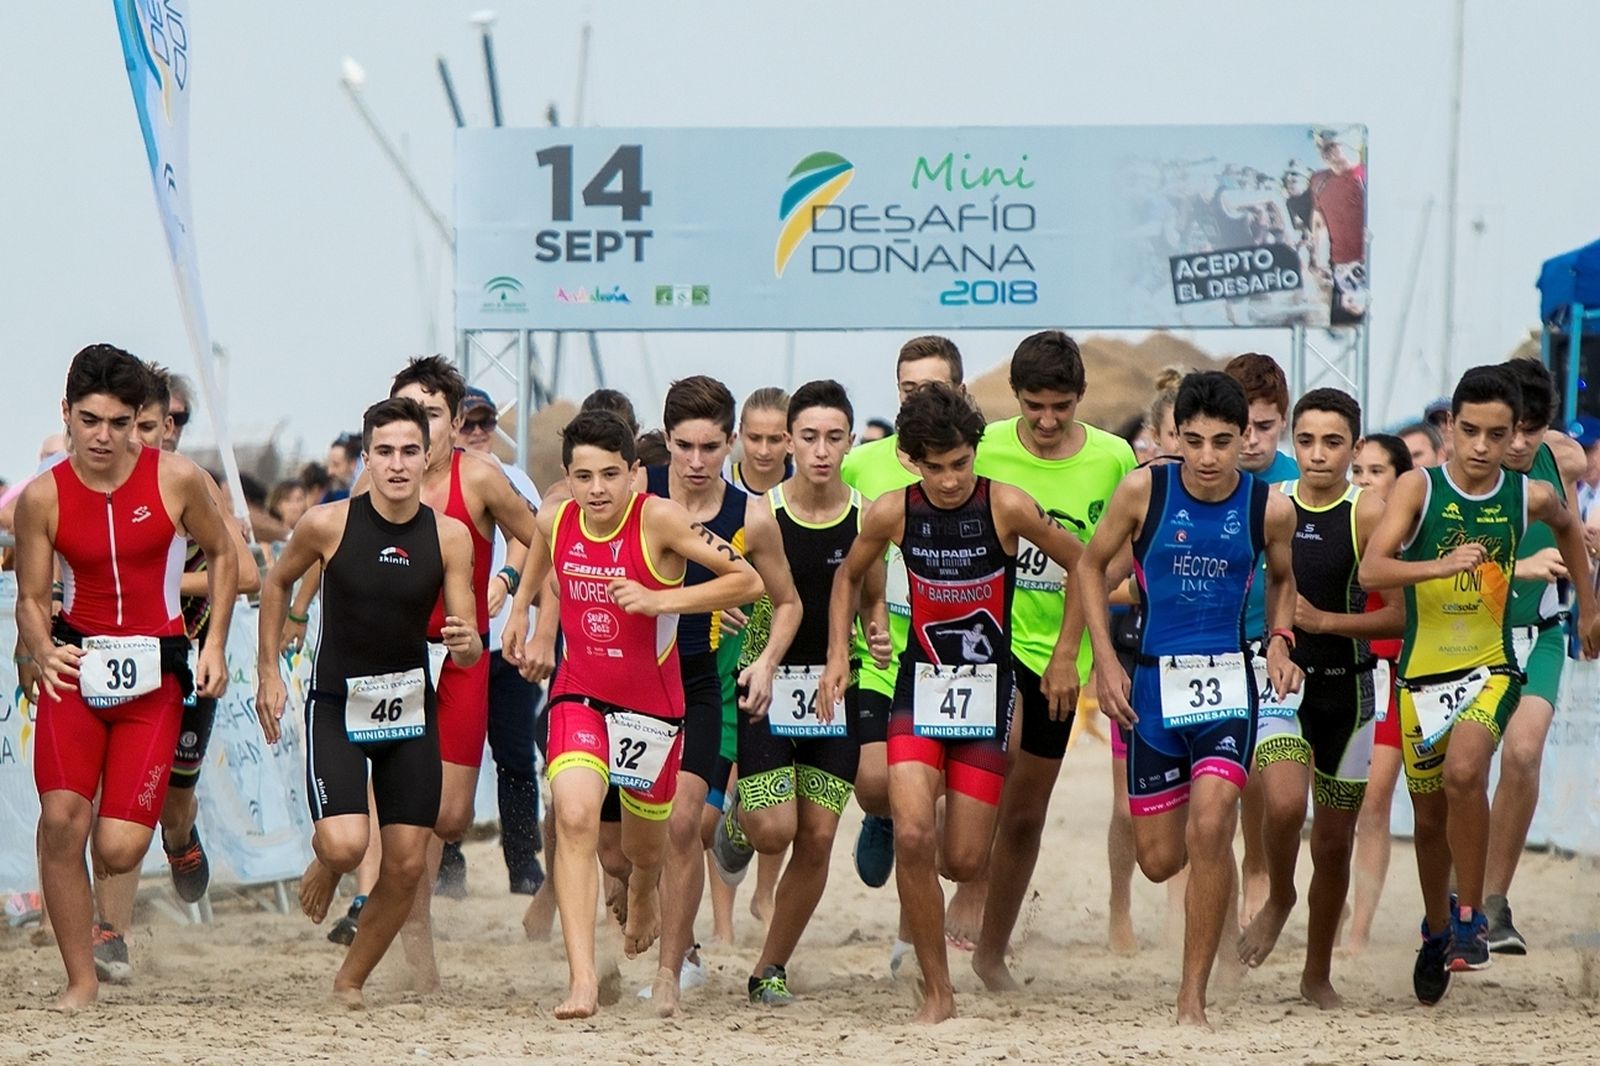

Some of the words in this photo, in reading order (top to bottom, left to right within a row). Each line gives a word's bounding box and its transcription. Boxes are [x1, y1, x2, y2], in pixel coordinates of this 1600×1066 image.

[536, 144, 653, 221] 14
[911, 153, 1035, 191] Mini
[812, 193, 1036, 233] DESAFÍO
[535, 230, 653, 262] SEPT
[812, 238, 1036, 274] DOÑANA
[1175, 247, 1275, 280] ACEPTO
[940, 280, 1038, 306] 2018
[1177, 282, 1203, 302] EL
[1207, 267, 1300, 297] DESAFÍO
[378, 554, 410, 566] skinfit
[912, 546, 939, 558] SAN
[941, 546, 987, 558] PABLO
[1016, 547, 1048, 576] 49
[1173, 550, 1228, 578] HÉCTOR
[562, 561, 626, 577] ISBILYA
[928, 584, 993, 603] BARRANCO
[1181, 579, 1216, 592] IMC
[107, 658, 137, 690] 39
[940, 688, 972, 719] 47
[1189, 677, 1222, 708] 33
[371, 697, 403, 722] 46
[615, 737, 648, 770] 32
[317, 778, 329, 805] skinfit
